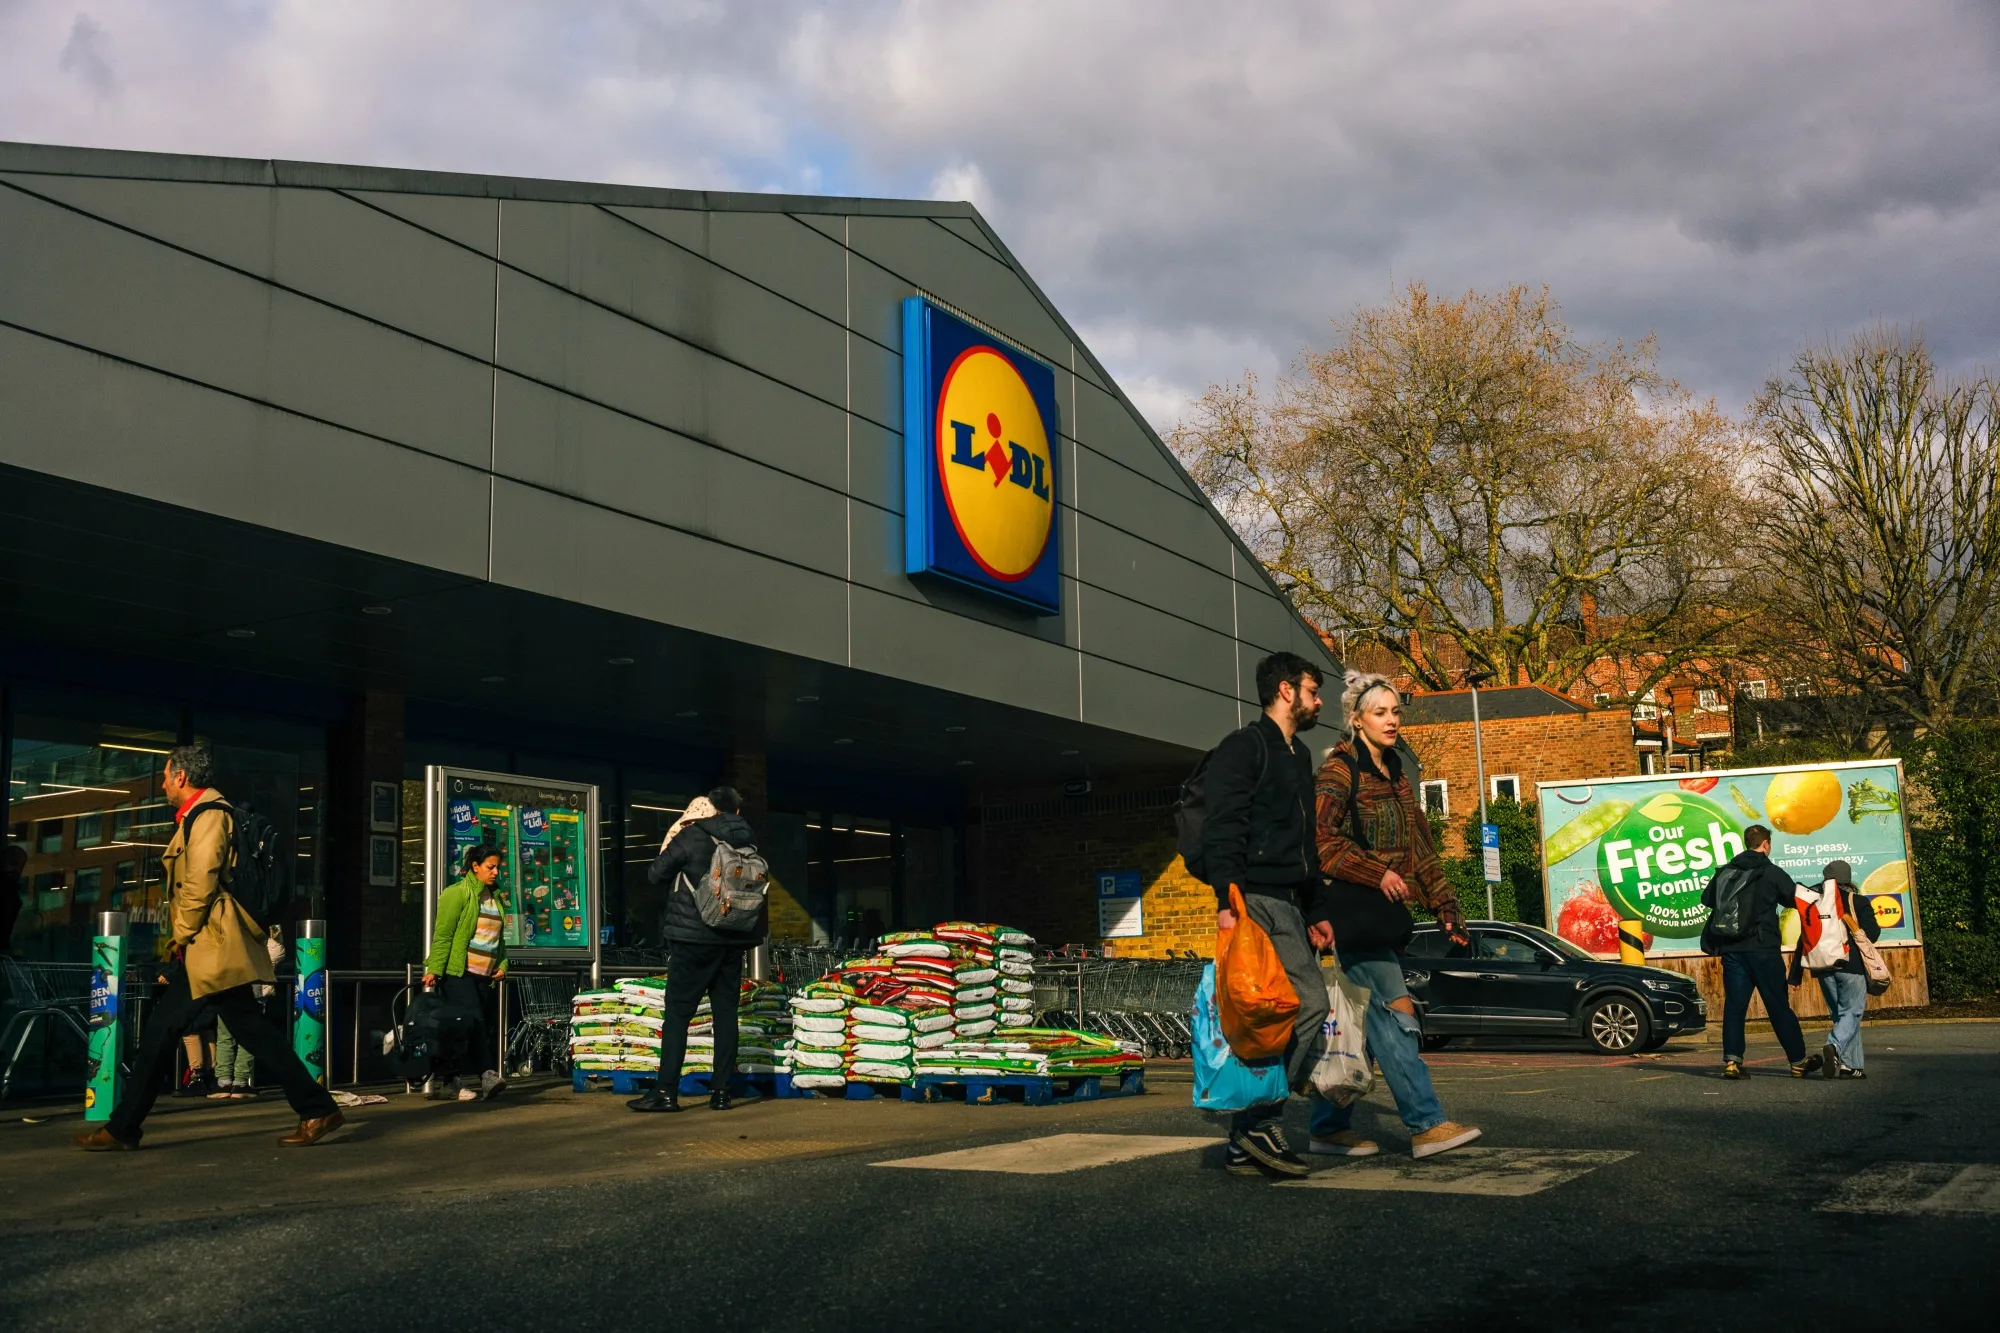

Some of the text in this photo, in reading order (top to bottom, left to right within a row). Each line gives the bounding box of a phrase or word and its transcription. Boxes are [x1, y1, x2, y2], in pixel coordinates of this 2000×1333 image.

[450, 804, 470, 814] Middle
[522, 810, 541, 820] Middle
[456, 811, 471, 824] Lidl
[528, 817, 542, 829] Lidl
[1648, 825, 1684, 843] Our
[1604, 822, 1745, 884] Fresh
[1783, 843, 1852, 856] Easy-peasy.
[1104, 879, 1113, 892] P
[1637, 871, 1714, 900] Promis
[1649, 903, 1711, 919] 100% HAP
[1646, 914, 1657, 923] OR
[1658, 918, 1680, 927] YOUR
[1681, 914, 1708, 927] MONEY
[90, 986, 111, 999] DEN
[90, 996, 108, 1009] ENT
